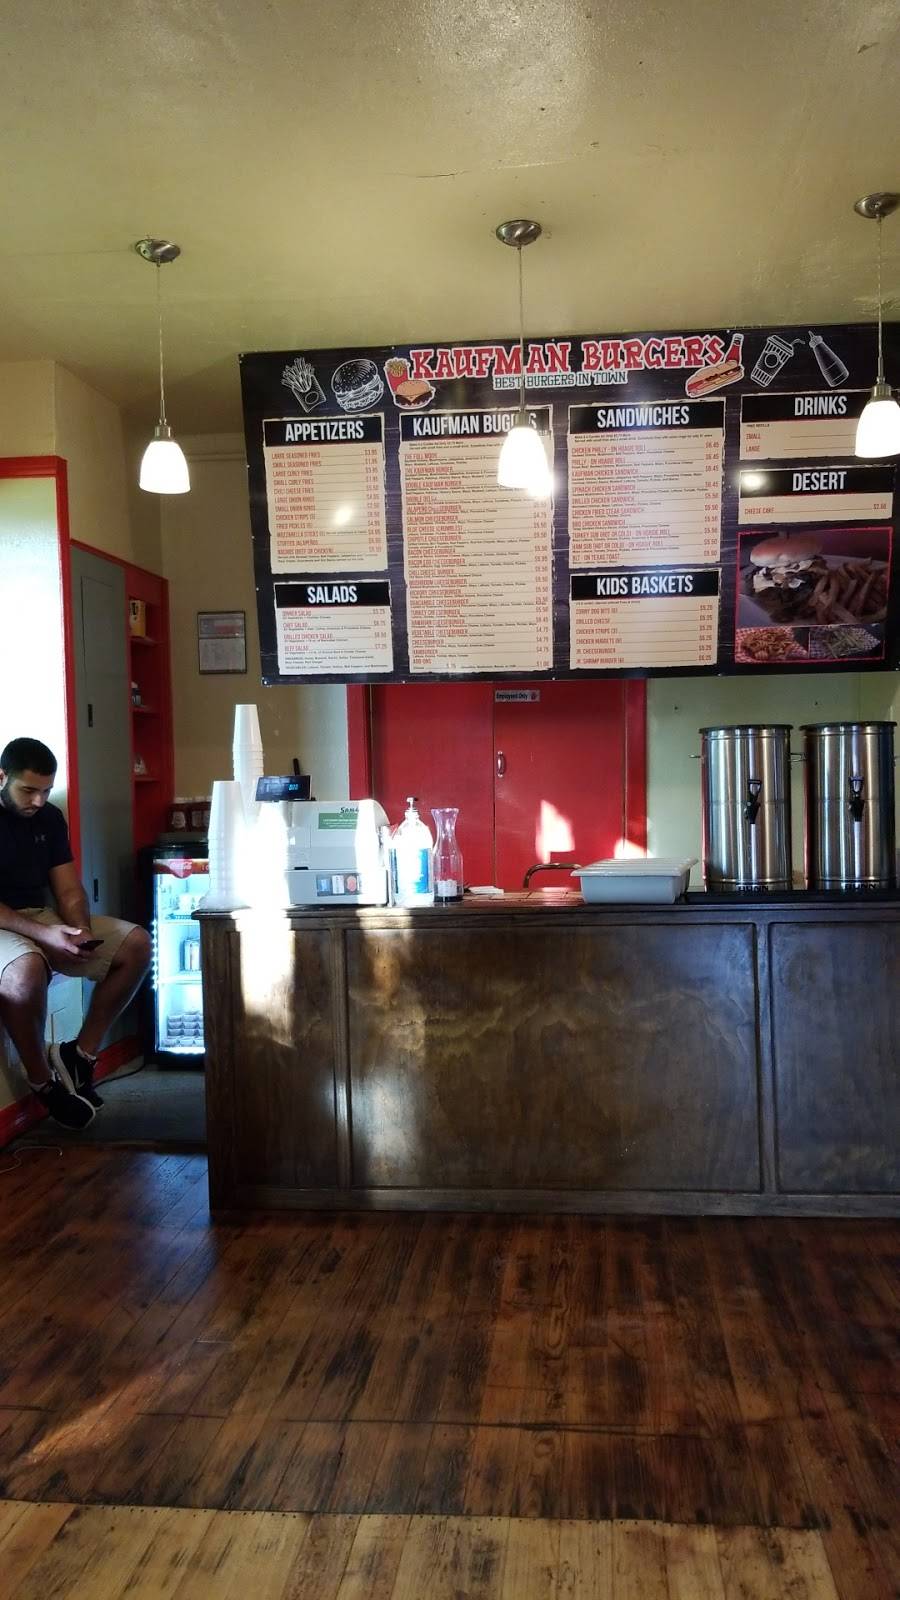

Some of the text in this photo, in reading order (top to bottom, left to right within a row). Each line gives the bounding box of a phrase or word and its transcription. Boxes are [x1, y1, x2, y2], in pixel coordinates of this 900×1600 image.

[410, 343, 570, 381] KAUFMAN
[494, 370, 628, 390] BEST BURGERS IN TOWN
[597, 405, 690, 429] SANDWICHES
[794, 395, 848, 417] DRINKS
[285, 420, 364, 442] APPETIZERS
[412, 414, 480, 436] KAUFMAN
[792, 471, 848, 492] DESERT
[307, 585, 358, 604] SALADS
[597, 574, 694, 596] KIDS BASKETS
